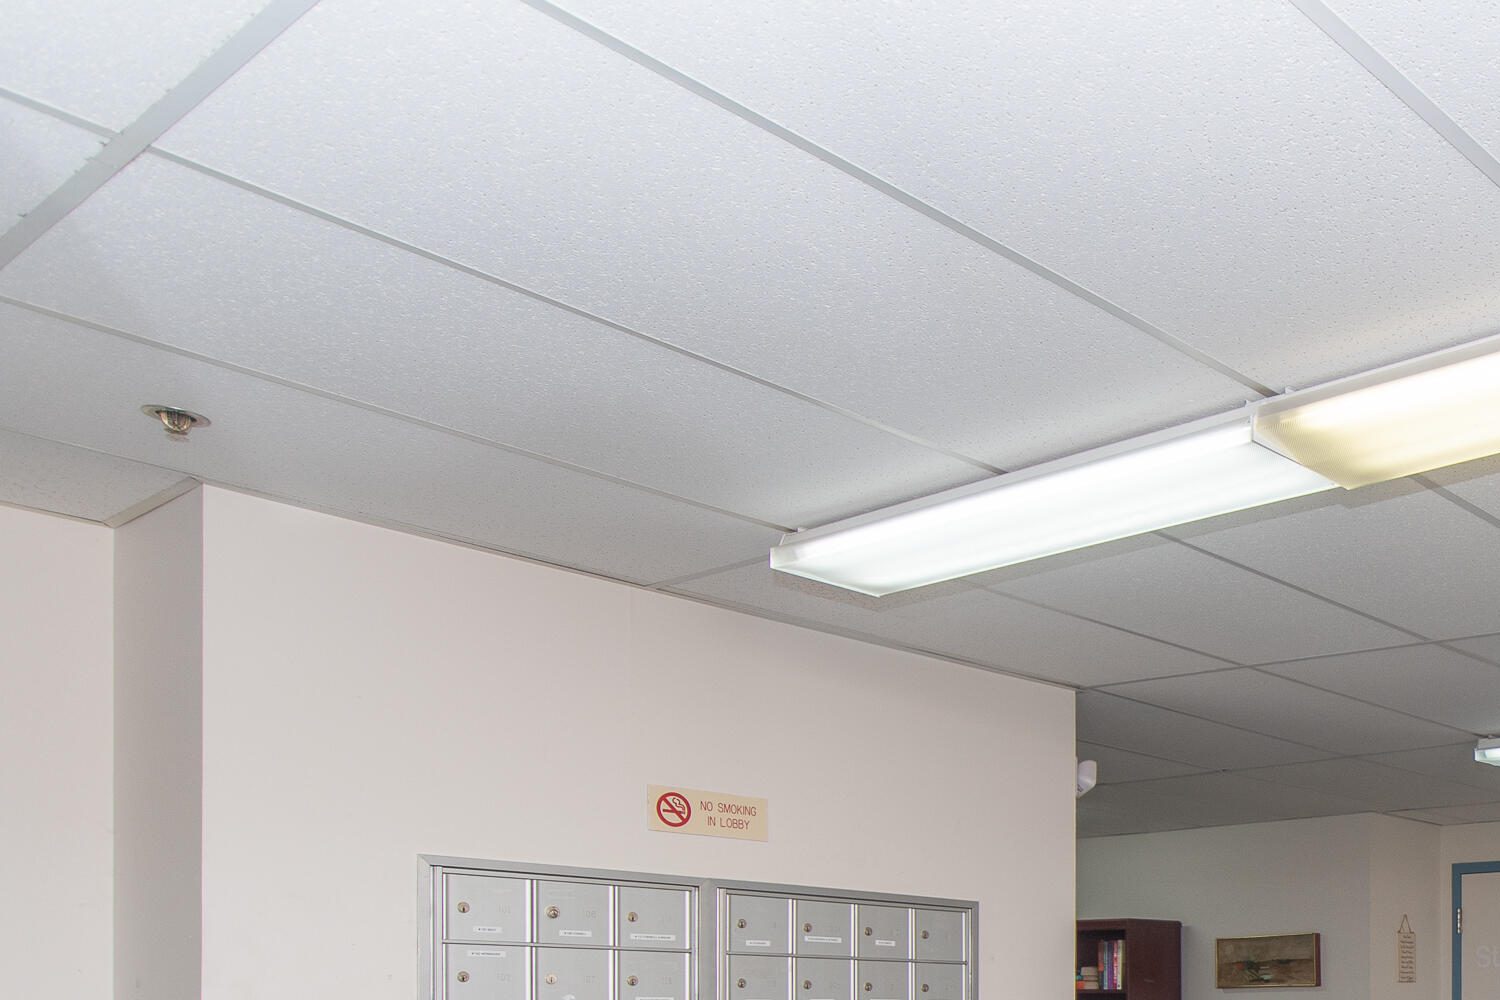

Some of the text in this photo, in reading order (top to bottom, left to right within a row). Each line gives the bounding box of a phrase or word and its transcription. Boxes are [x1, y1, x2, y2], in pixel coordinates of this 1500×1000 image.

[700, 801, 757, 816] NO SMOKING
[707, 816, 750, 829] IN LOBBY
